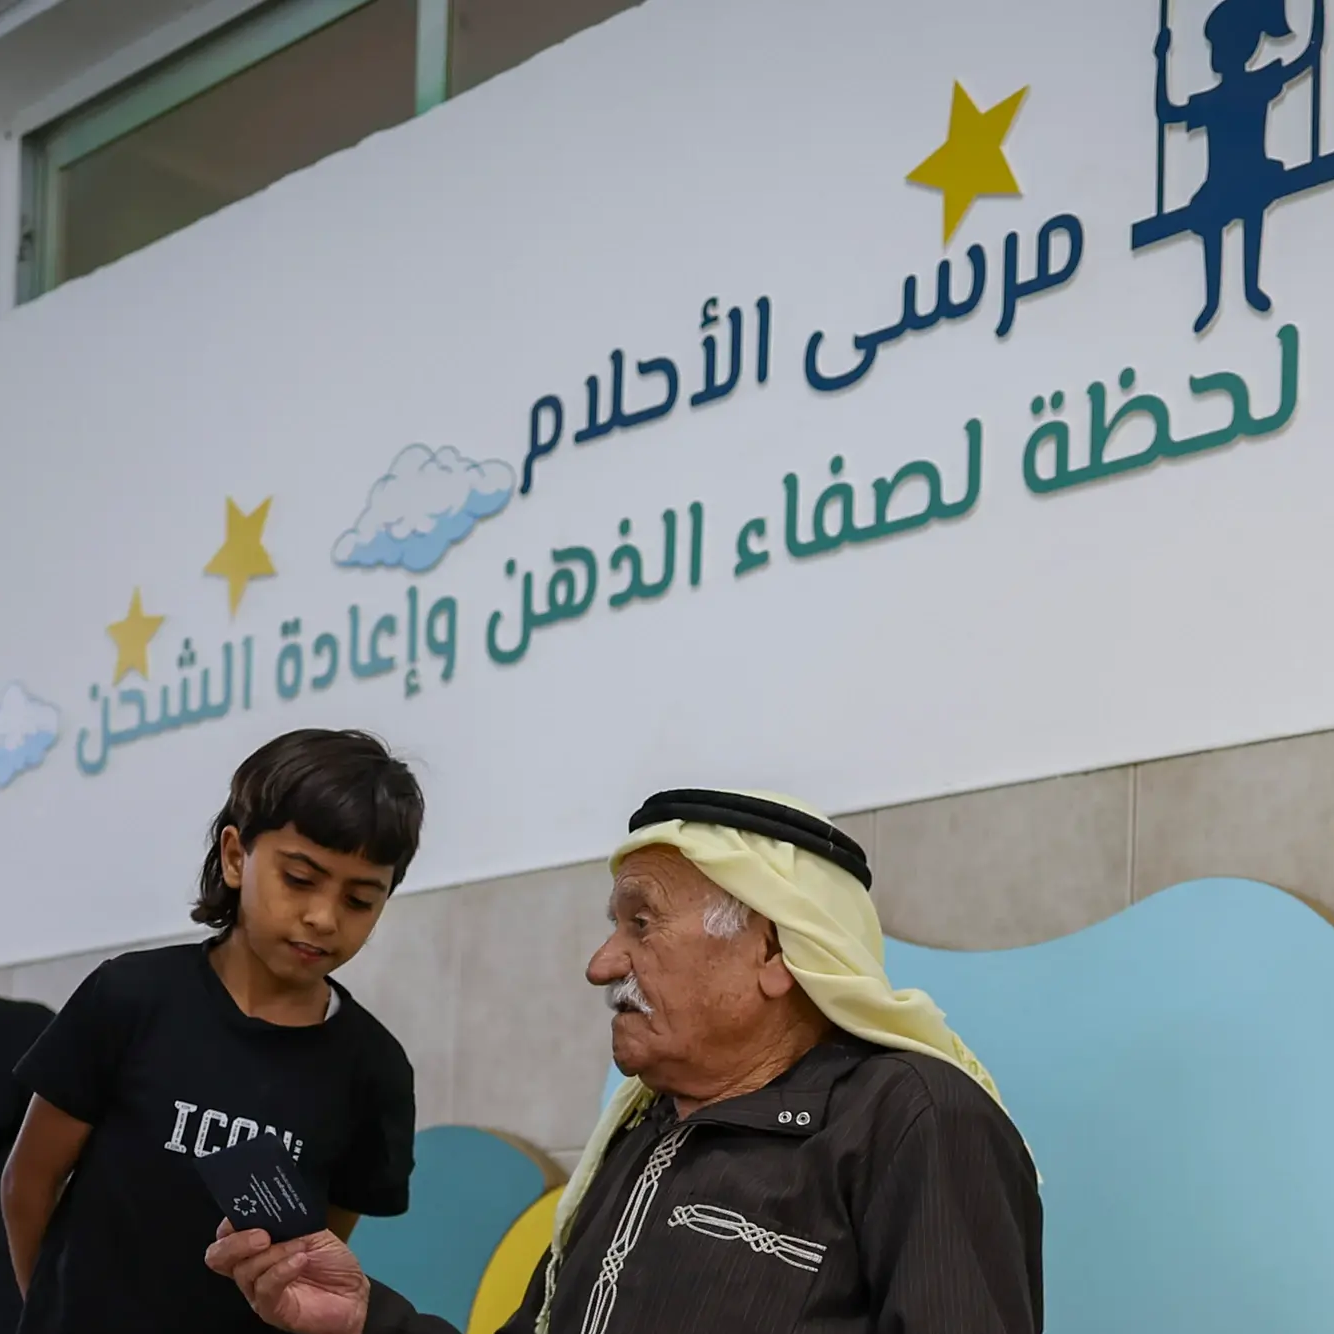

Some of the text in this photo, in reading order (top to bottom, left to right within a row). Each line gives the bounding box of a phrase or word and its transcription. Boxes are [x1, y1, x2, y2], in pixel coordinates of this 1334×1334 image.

[521, 209, 1083, 495] مرسى الأحلام
[1022, 324, 1299, 494] لحظة
[734, 419, 982, 576] لصفاء
[277, 587, 457, 697] وإعادة
[487, 502, 703, 664] الذهن
[76, 635, 253, 774] الشحن
